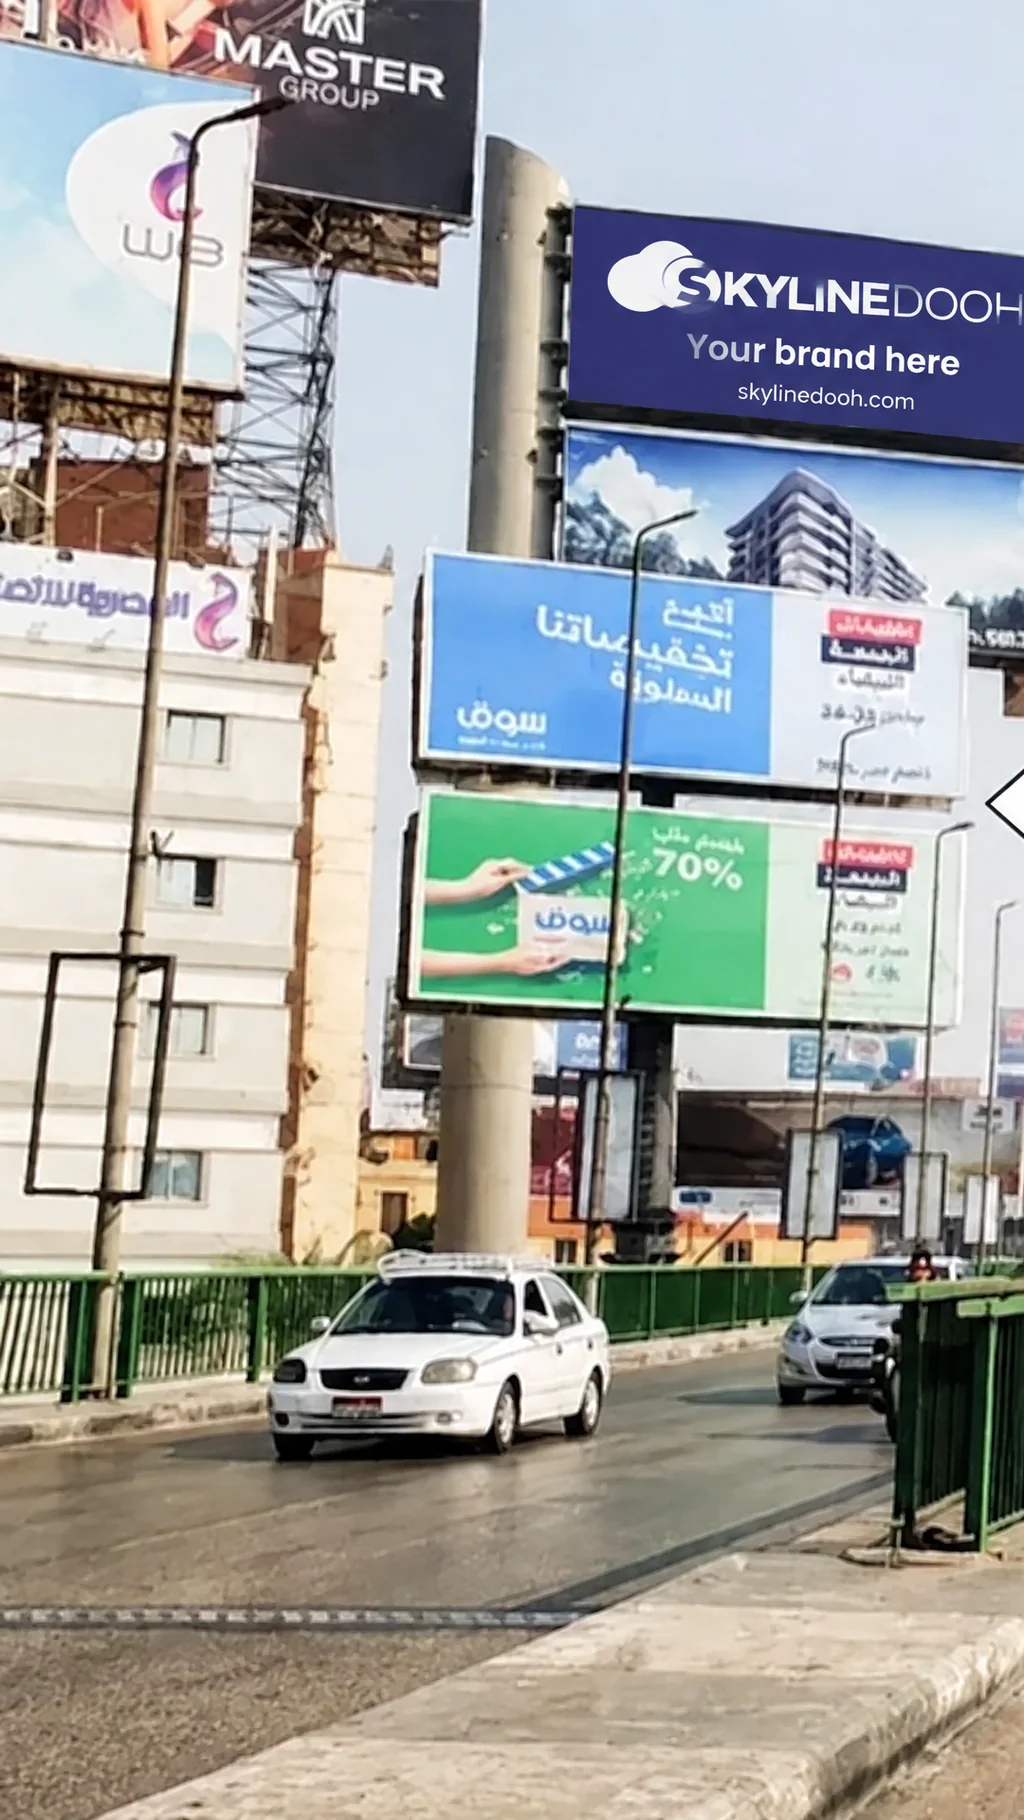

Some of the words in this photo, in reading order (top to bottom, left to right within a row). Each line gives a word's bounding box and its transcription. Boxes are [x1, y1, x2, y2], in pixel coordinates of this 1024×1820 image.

[214, 31, 446, 99] MASTER
[278, 75, 380, 111] GROUP
[687, 333, 766, 365] Your
[774, 338, 876, 371] brand
[885, 345, 961, 376] here
[737, 382, 915, 411] skylinedooh.com
[457, 700, 547, 737] سوق
[652, 846, 744, 893] 70%
